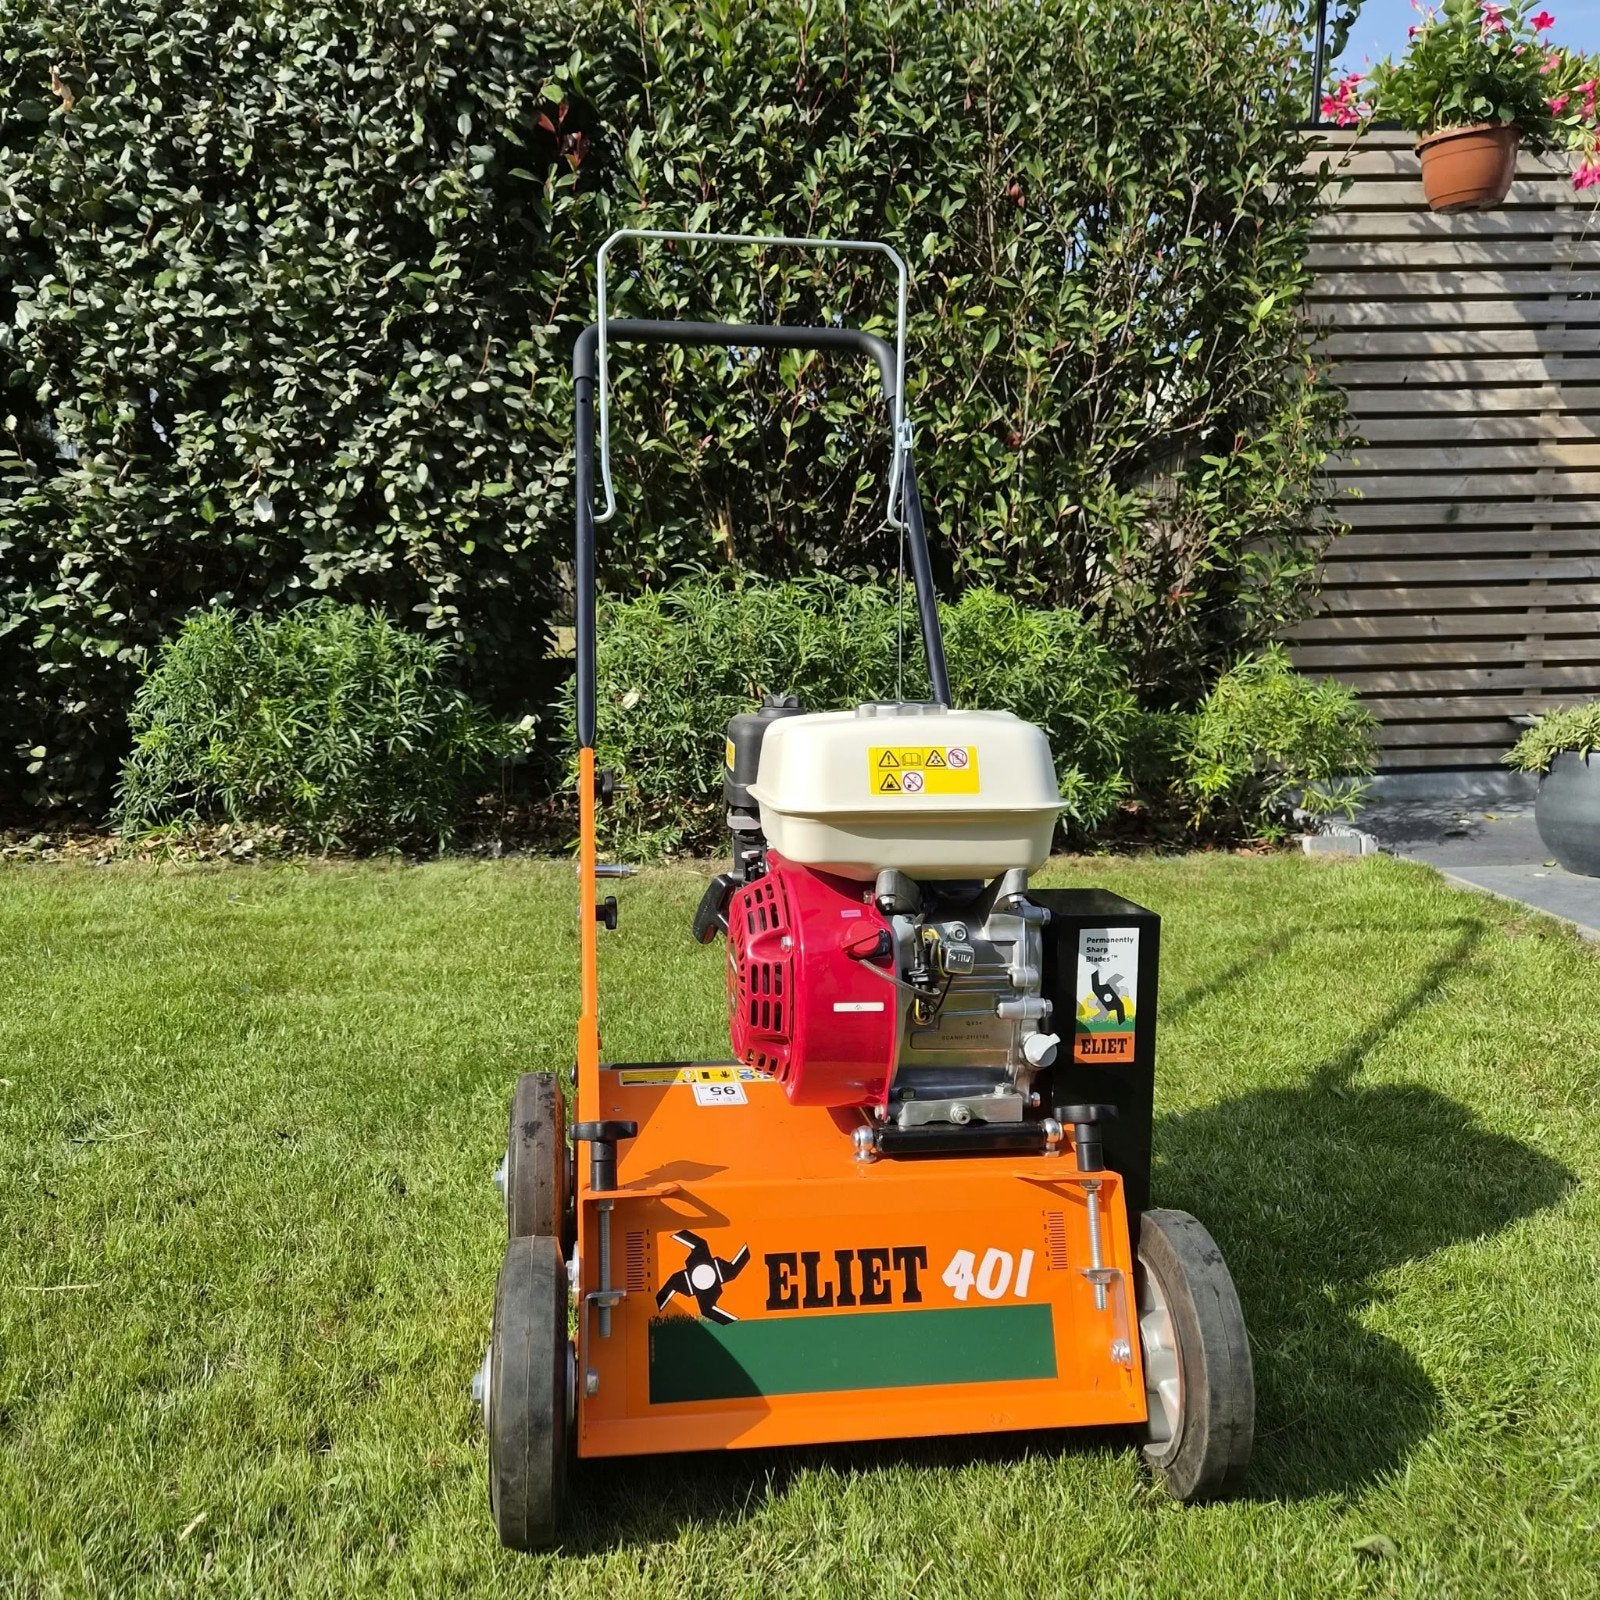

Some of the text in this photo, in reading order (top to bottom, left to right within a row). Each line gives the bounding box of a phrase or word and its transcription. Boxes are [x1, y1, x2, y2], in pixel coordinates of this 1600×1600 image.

[1086, 936, 1134, 944] Permanently
[1086, 946, 1108, 954] Sharp
[1081, 1038, 1128, 1054] ELIET
[710, 1086, 736, 1096] 95
[764, 1246, 1035, 1311] ELIET 401
